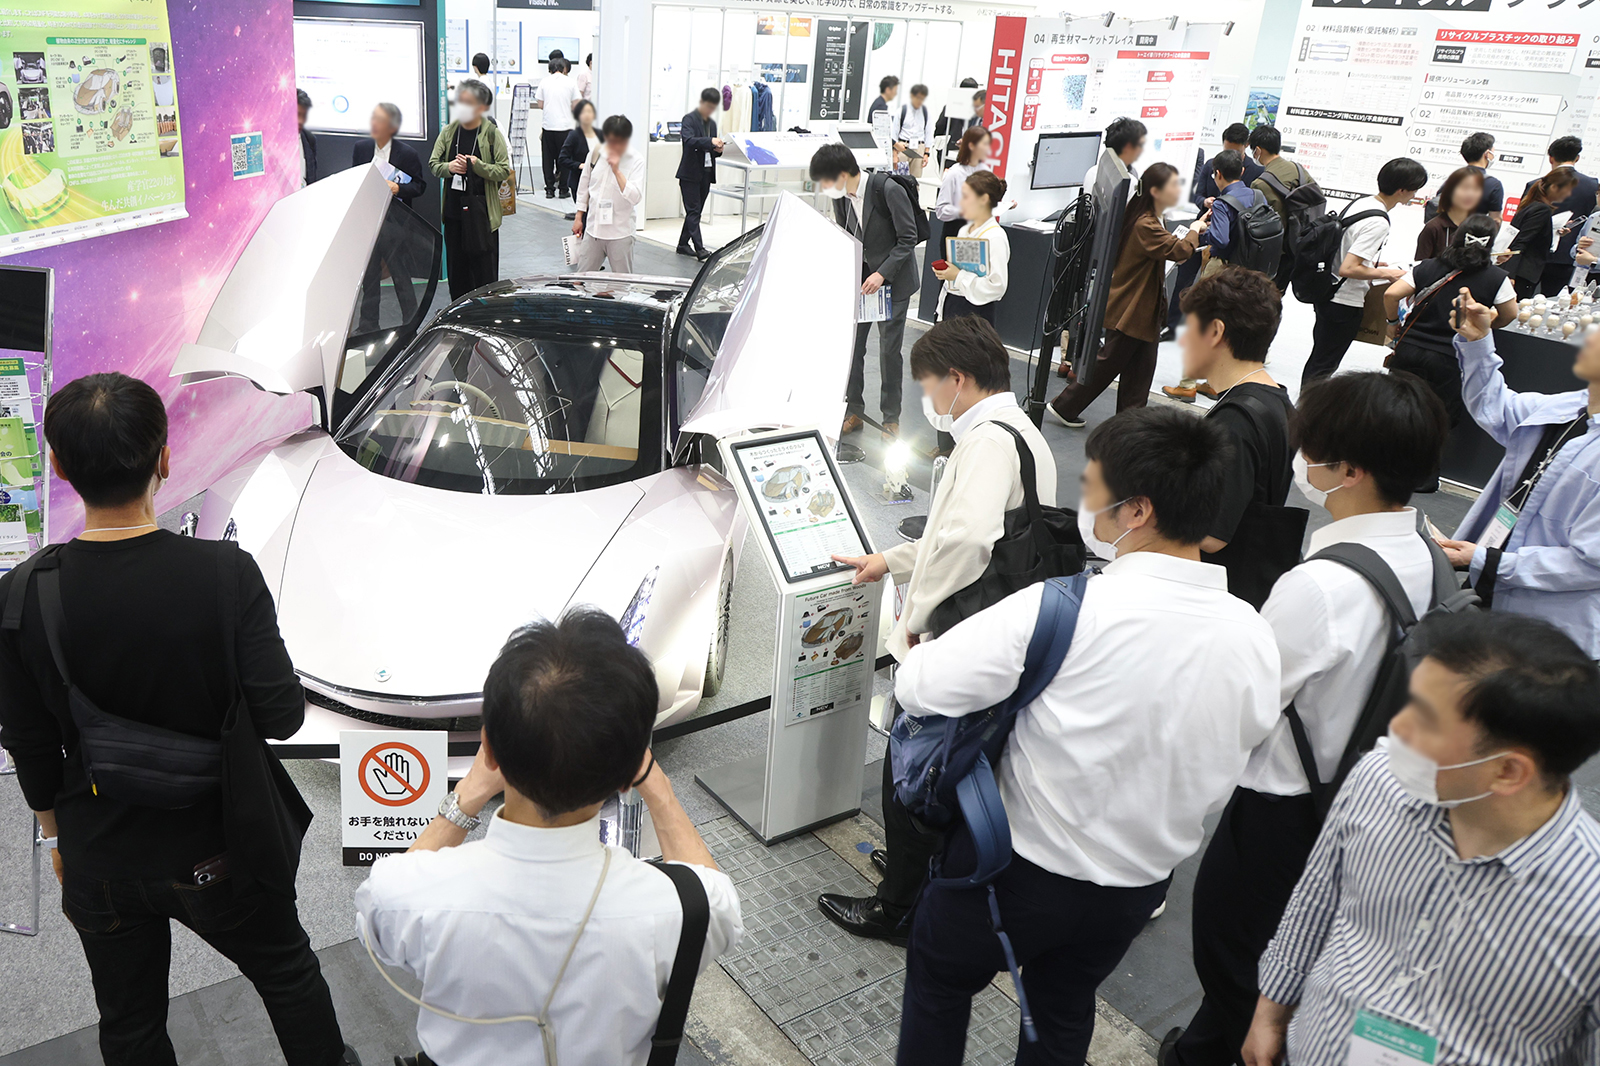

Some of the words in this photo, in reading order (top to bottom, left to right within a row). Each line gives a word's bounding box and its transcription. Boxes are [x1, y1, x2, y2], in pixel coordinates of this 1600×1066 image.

[1034, 33, 1046, 44] 04
[1050, 33, 1134, 45] 再生材マーケットプレイス
[1440, 31, 1575, 45] リサイクルプラスチックの取り組み
[1593, 35, 1600, 43] 0
[1429, 75, 1490, 86] 提供ソリューション群
[1424, 91, 1435, 99] 01
[1445, 91, 1539, 103] 高品質リサイクルプラスチック材料
[986, 49, 1016, 173] HITACH
[1419, 110, 1431, 118] 02
[1298, 128, 1363, 141] 成形材料評価システム
[1414, 129, 1426, 137] 03
[1435, 127, 1476, 136] 成形材料評価シ
[1410, 147, 1422, 155] 04
[1429, 147, 1461, 155] 再生材マー
[101, 190, 177, 212] 生んだ共創イノベーション
[349, 816, 435, 827] お手を触れない
[373, 831, 417, 841] ください
[359, 852, 373, 861] DO
[375, 853, 394, 861] NO
